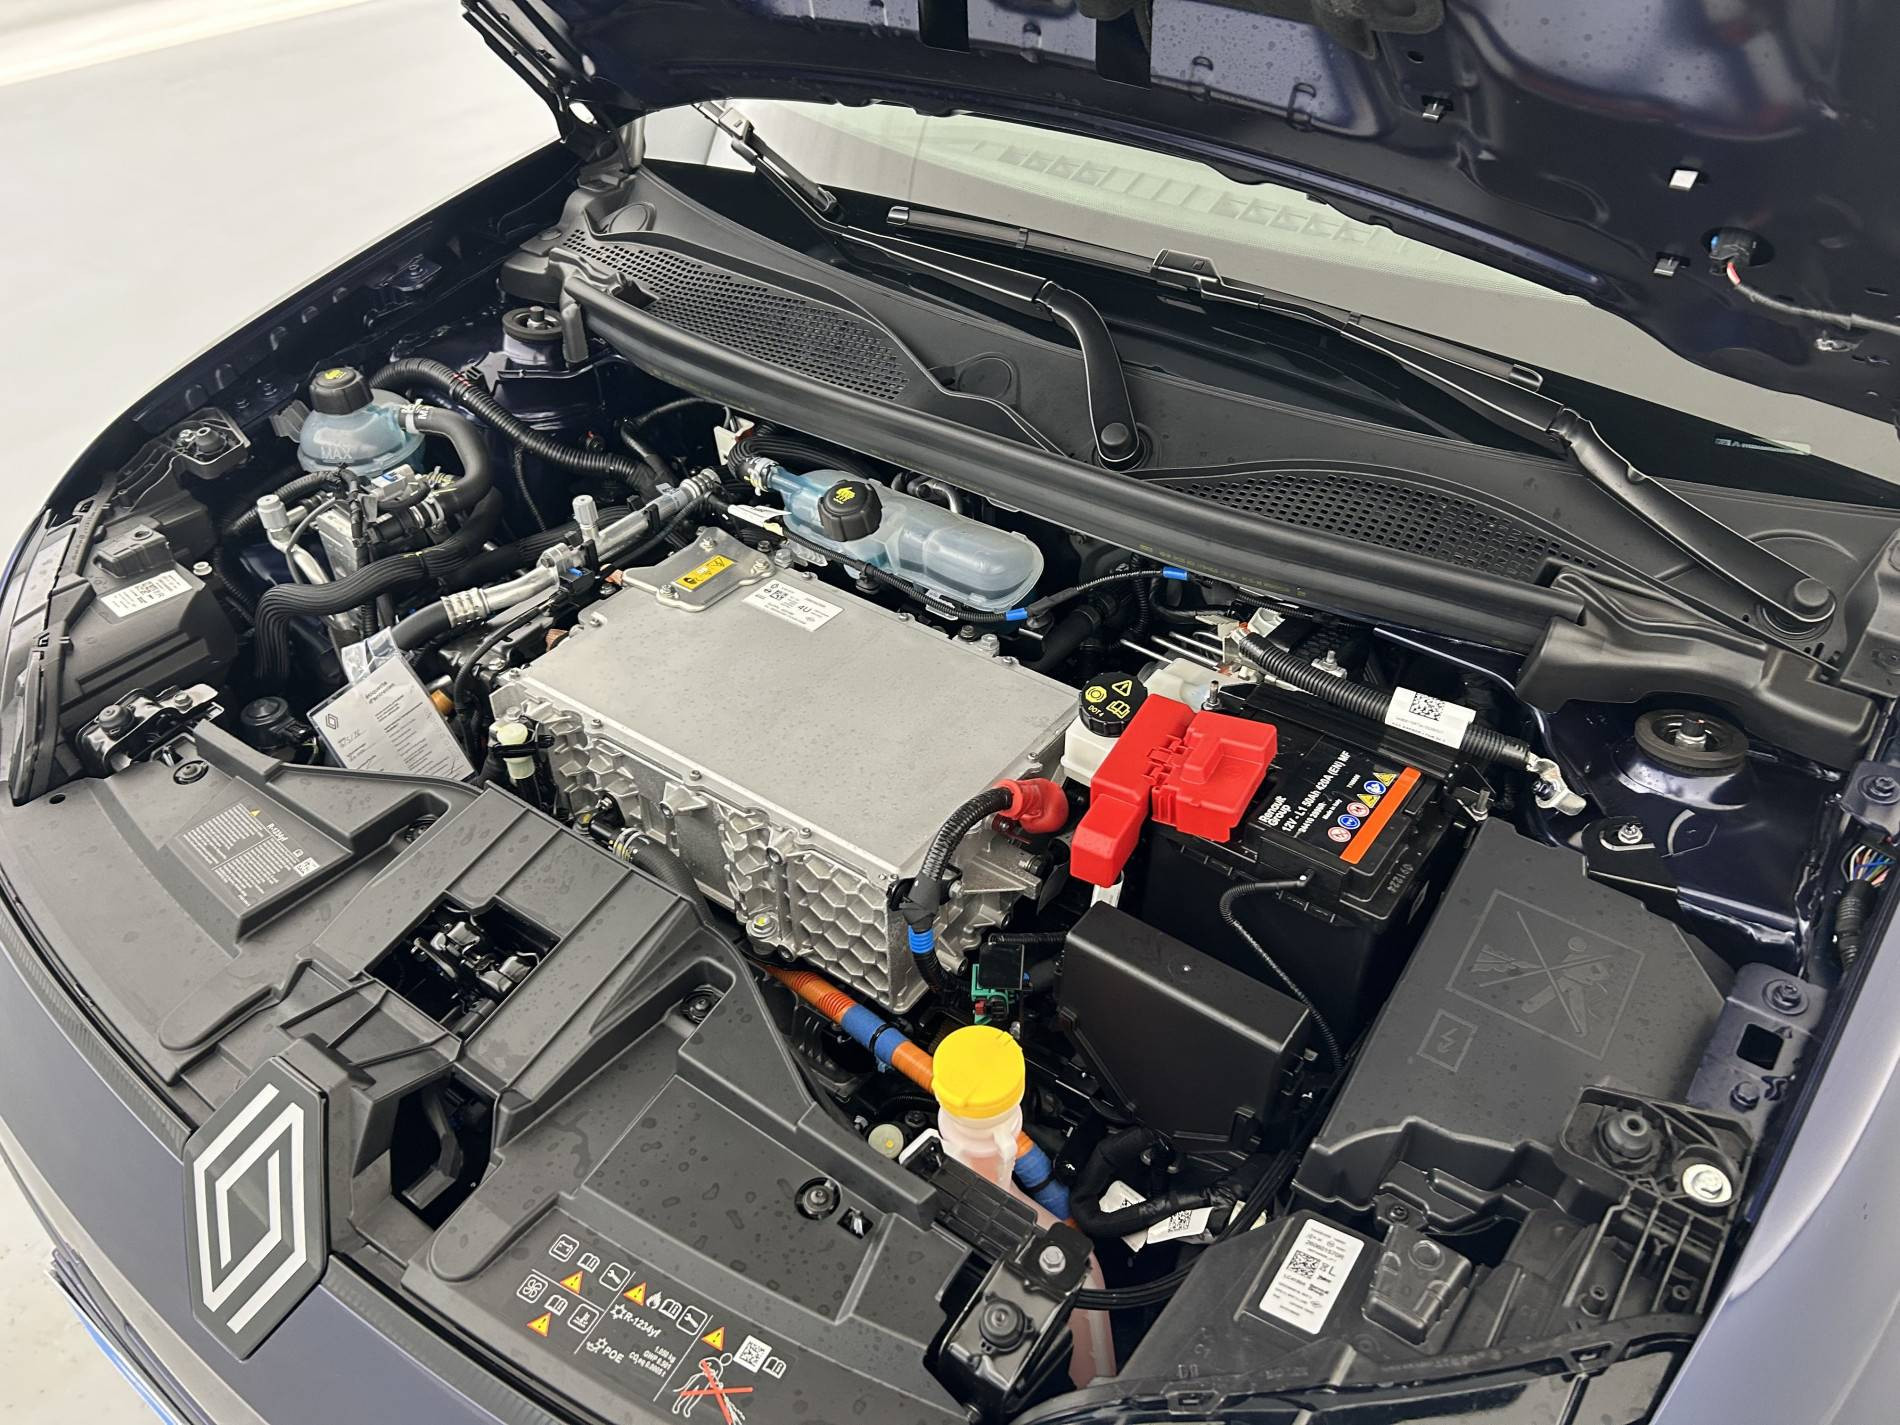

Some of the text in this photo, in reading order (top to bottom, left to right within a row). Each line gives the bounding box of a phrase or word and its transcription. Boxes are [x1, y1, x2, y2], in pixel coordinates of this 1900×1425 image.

[320, 446, 353, 460] MAX
[1088, 705, 1101, 714] DOT
[1337, 750, 1351, 763] MF
[1327, 761, 1346, 776] (EN)
[1315, 774, 1333, 791] 420A
[1302, 789, 1320, 807] 50Ah
[1258, 795, 1287, 823] Renault
[1268, 804, 1291, 827] Group
[1298, 806, 1308, 816] L1
[1282, 817, 1297, 832] 12V
[623, 1312, 662, 1338] R-1234yf
[602, 1347, 625, 1364] POE
[643, 1350, 659, 1362] GWP
[667, 1353, 677, 1364] kg
